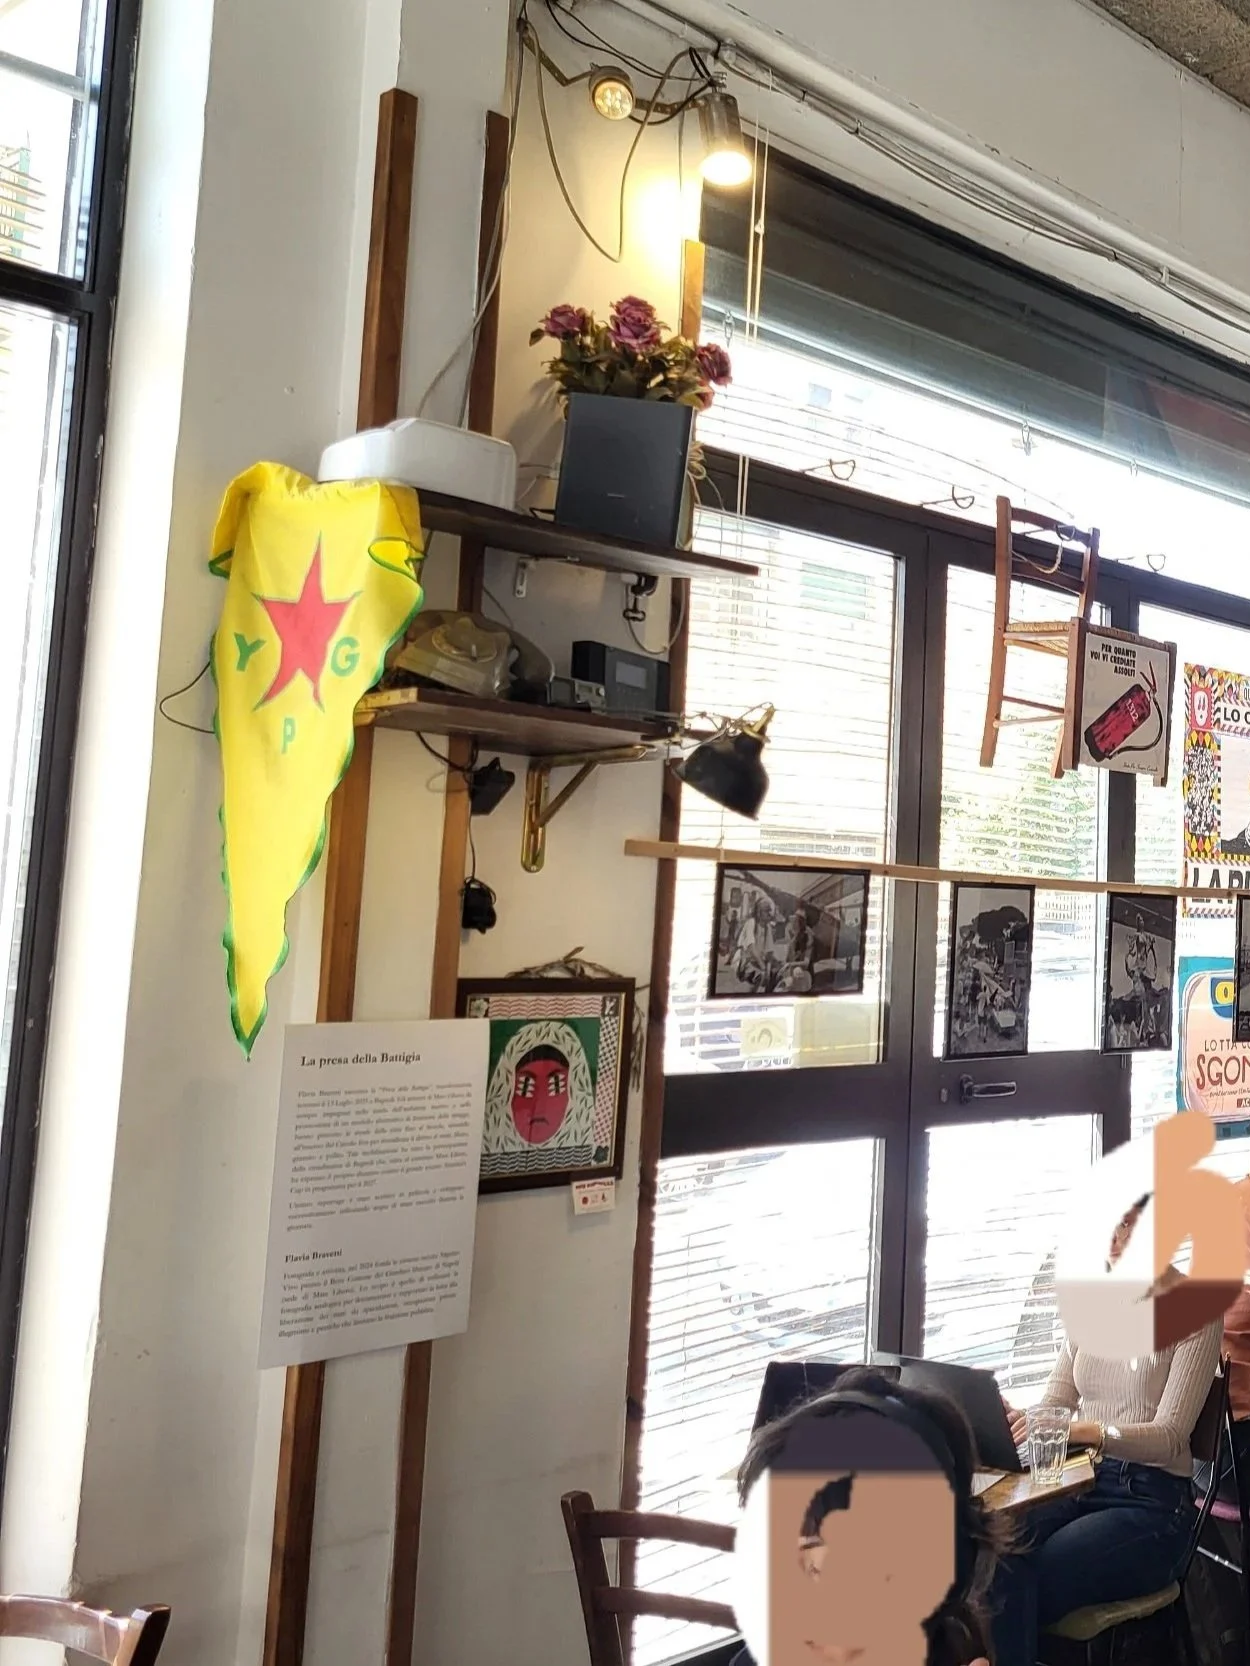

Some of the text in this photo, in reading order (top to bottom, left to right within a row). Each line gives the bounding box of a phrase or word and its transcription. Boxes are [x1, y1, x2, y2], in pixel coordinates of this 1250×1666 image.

[234, 632, 361, 677] Y G
[1090, 650, 1136, 668] VOI VI CREDIATE
[1101, 643, 1136, 659] PER QUANTO
[1223, 706, 1241, 724] LO
[281, 716, 296, 755] P
[1204, 1039, 1238, 1052] LOTTA
[300, 1051, 421, 1068] La presa della Battigia
[285, 1253, 310, 1264] Flavia
